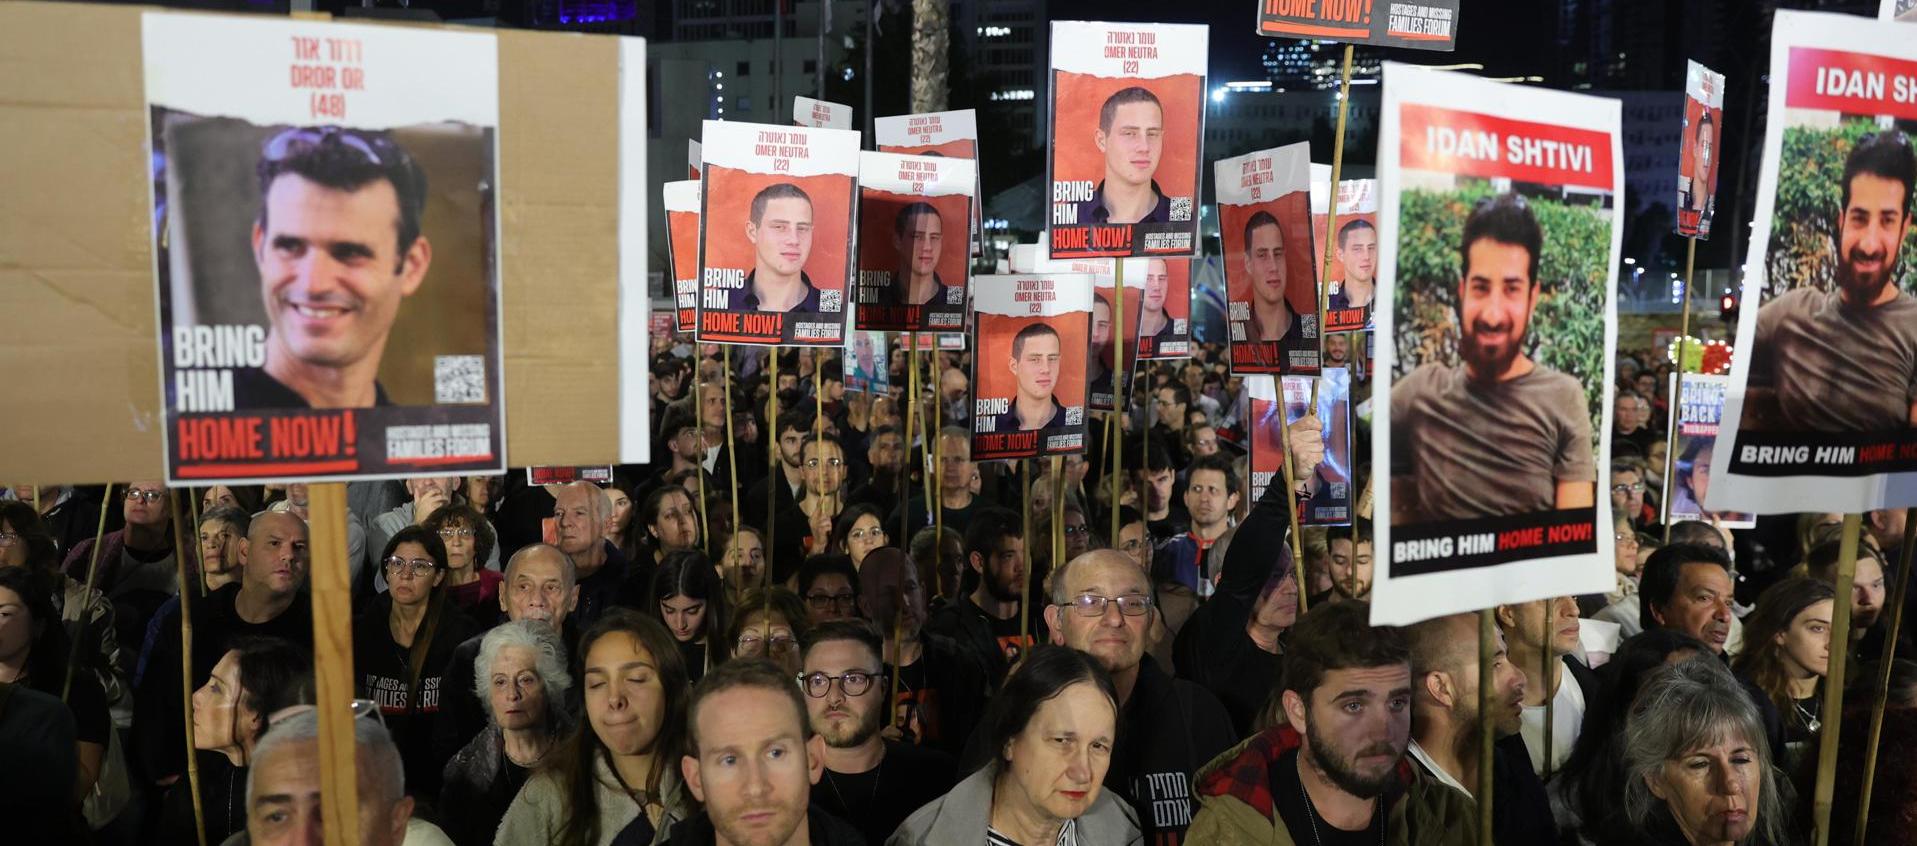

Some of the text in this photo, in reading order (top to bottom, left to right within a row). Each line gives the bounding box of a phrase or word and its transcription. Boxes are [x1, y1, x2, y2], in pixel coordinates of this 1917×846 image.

[1389, 15, 1451, 37] FAMILIES FORUM
[1104, 46, 1158, 60] OMER NEUTRA
[290, 65, 365, 90] DROR OR
[1123, 60, 1139, 75] (22)
[1816, 66, 1885, 101] IDAN
[311, 92, 345, 119] (48)
[755, 144, 809, 159] OMER NEUTRA
[1426, 126, 1593, 173] IDAN SHTIVI
[773, 158, 790, 171] (22)
[898, 171, 915, 181] OMER
[912, 182, 925, 193] (22)
[1053, 181, 1094, 202] BRING
[1053, 203, 1078, 225] HIM
[1052, 224, 1132, 249] HOME NOW!
[677, 279, 697, 294] BRIN
[704, 268, 745, 289] BRING
[859, 270, 891, 287] BRING
[703, 289, 728, 309] HIM
[859, 287, 879, 304] HIM
[1014, 291, 1056, 302] OMER NEUTRA
[1029, 302, 1042, 313] (22)
[1229, 301, 1250, 321] BRING
[1340, 308, 1364, 324] NOW!
[702, 311, 783, 335] HOME NOW!
[1230, 322, 1248, 342] HIM
[174, 324, 267, 369] BRING
[175, 369, 235, 413] HIM
[976, 398, 1009, 416] BRING
[1681, 404, 1716, 423] BACK
[975, 415, 996, 433] HIM
[178, 408, 357, 461] HOME NOW!
[975, 429, 1038, 451] HOME NOW!
[386, 439, 445, 459] FAMILIES
[1740, 445, 1809, 464] BRING
[1814, 446, 1855, 464] HIM
[1858, 443, 1896, 463] HOME
[1393, 523, 1593, 564] BRING HIM HOME NOW!
[1153, 798, 1192, 828] אותם
